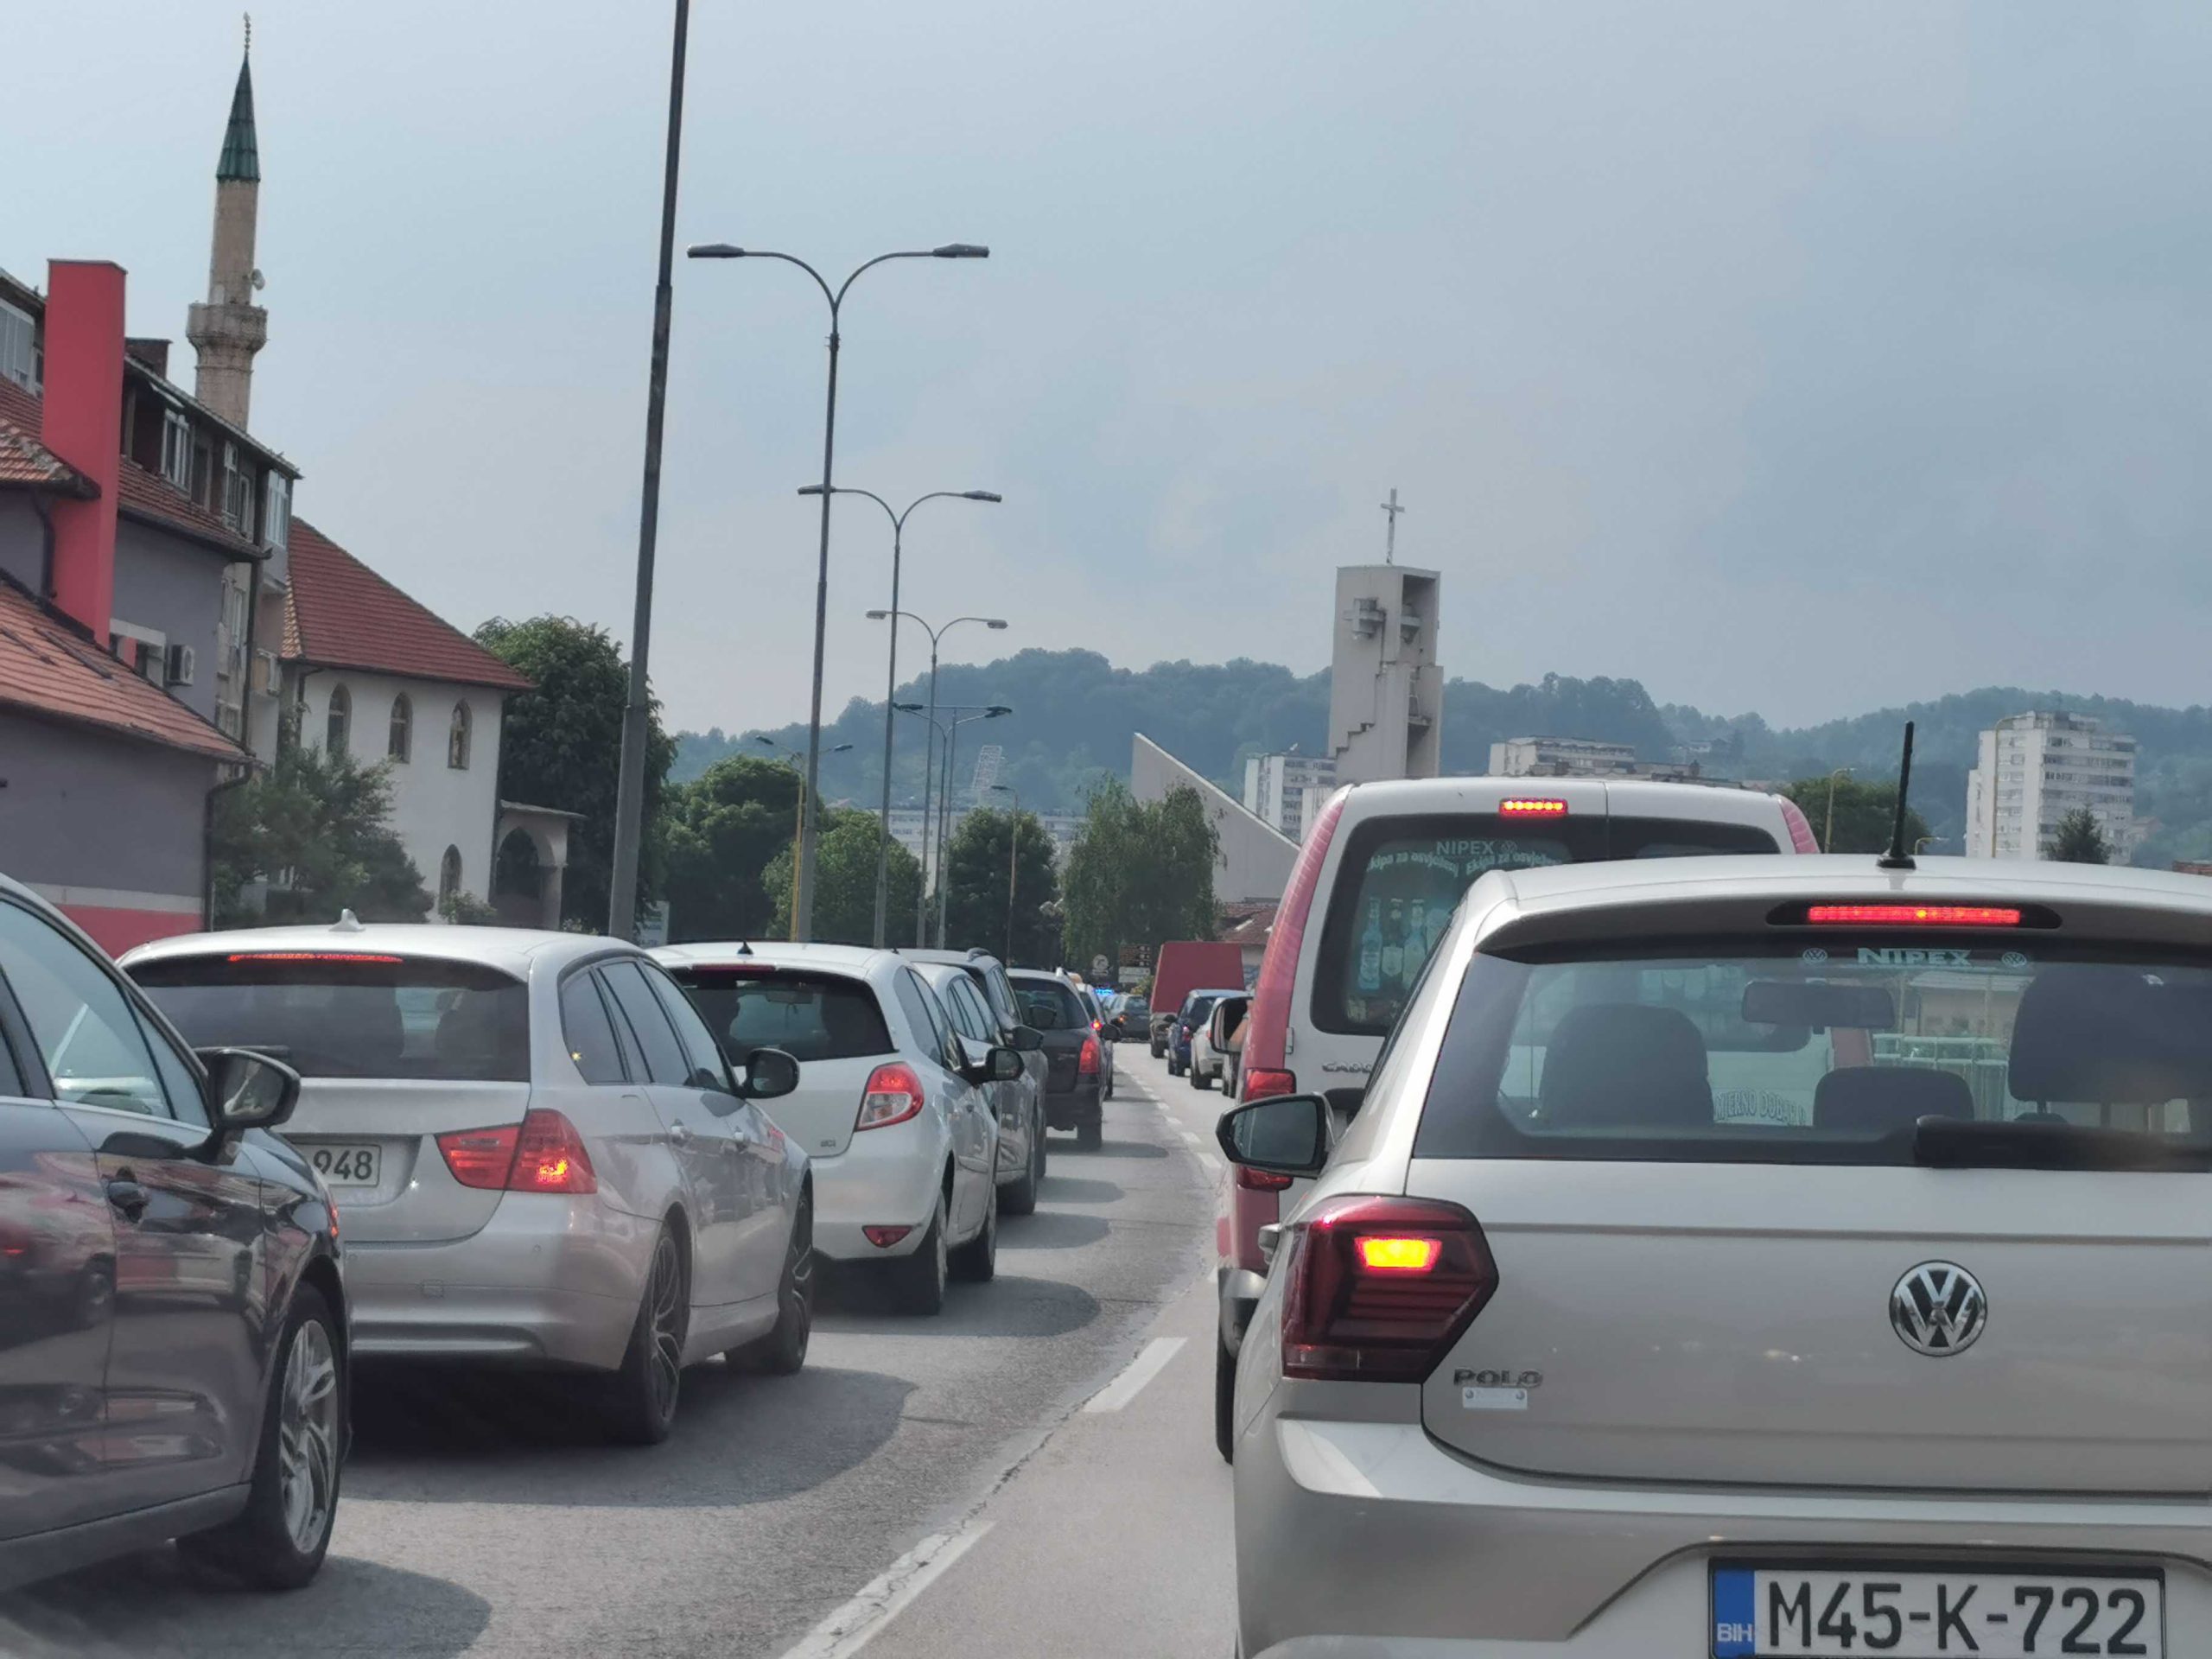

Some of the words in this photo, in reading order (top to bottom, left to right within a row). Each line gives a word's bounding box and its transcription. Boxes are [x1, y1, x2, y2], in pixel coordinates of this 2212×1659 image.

[1436, 841, 1495, 855] NIPEX
[1395, 851, 1408, 863] za
[1497, 853, 1510, 864] za
[1857, 947, 1973, 967] NIPEX
[1453, 1367, 1543, 1388] POLO
[1717, 1622, 1752, 1642] BIH
[1768, 1580, 2147, 1655] M45-K-722
